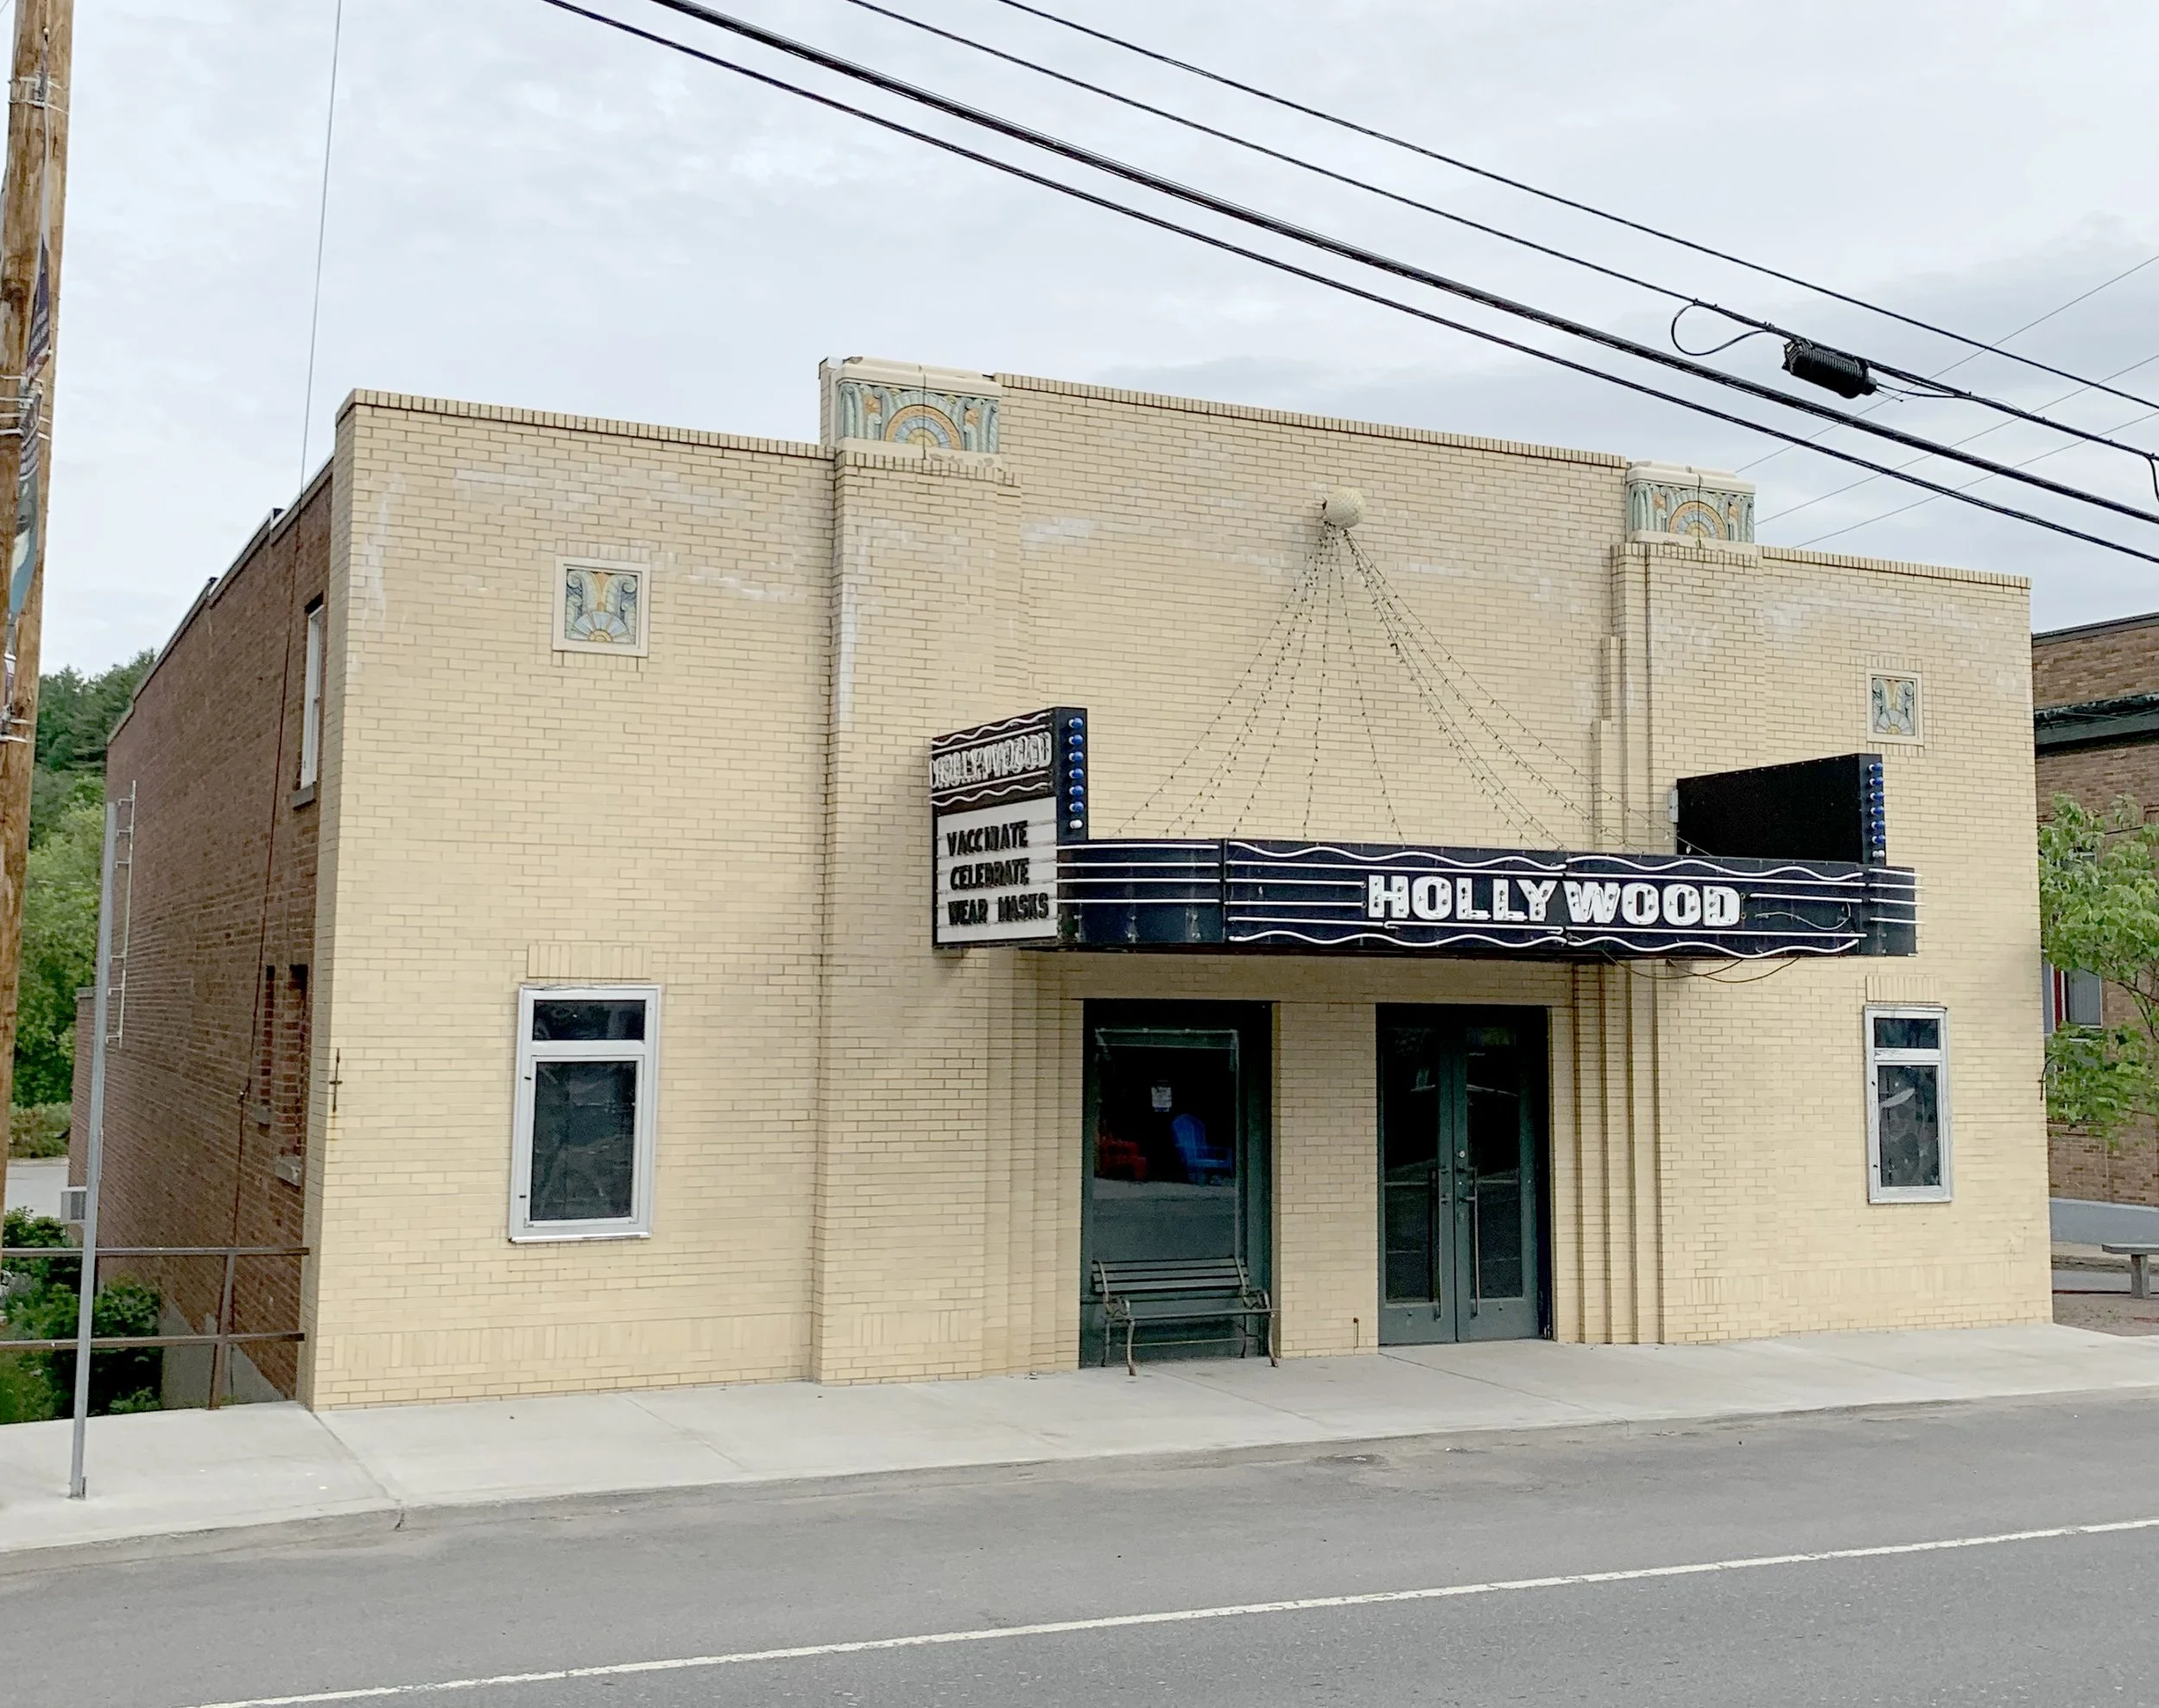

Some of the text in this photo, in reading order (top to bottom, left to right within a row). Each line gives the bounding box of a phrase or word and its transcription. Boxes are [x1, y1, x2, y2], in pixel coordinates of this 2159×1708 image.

[947, 820, 1029, 857] VACCINATE
[950, 857, 1029, 890] CELEBRATE
[947, 892, 1049, 926] WEAR MASKS
[1368, 874, 1741, 927] HOLLYWOOD
